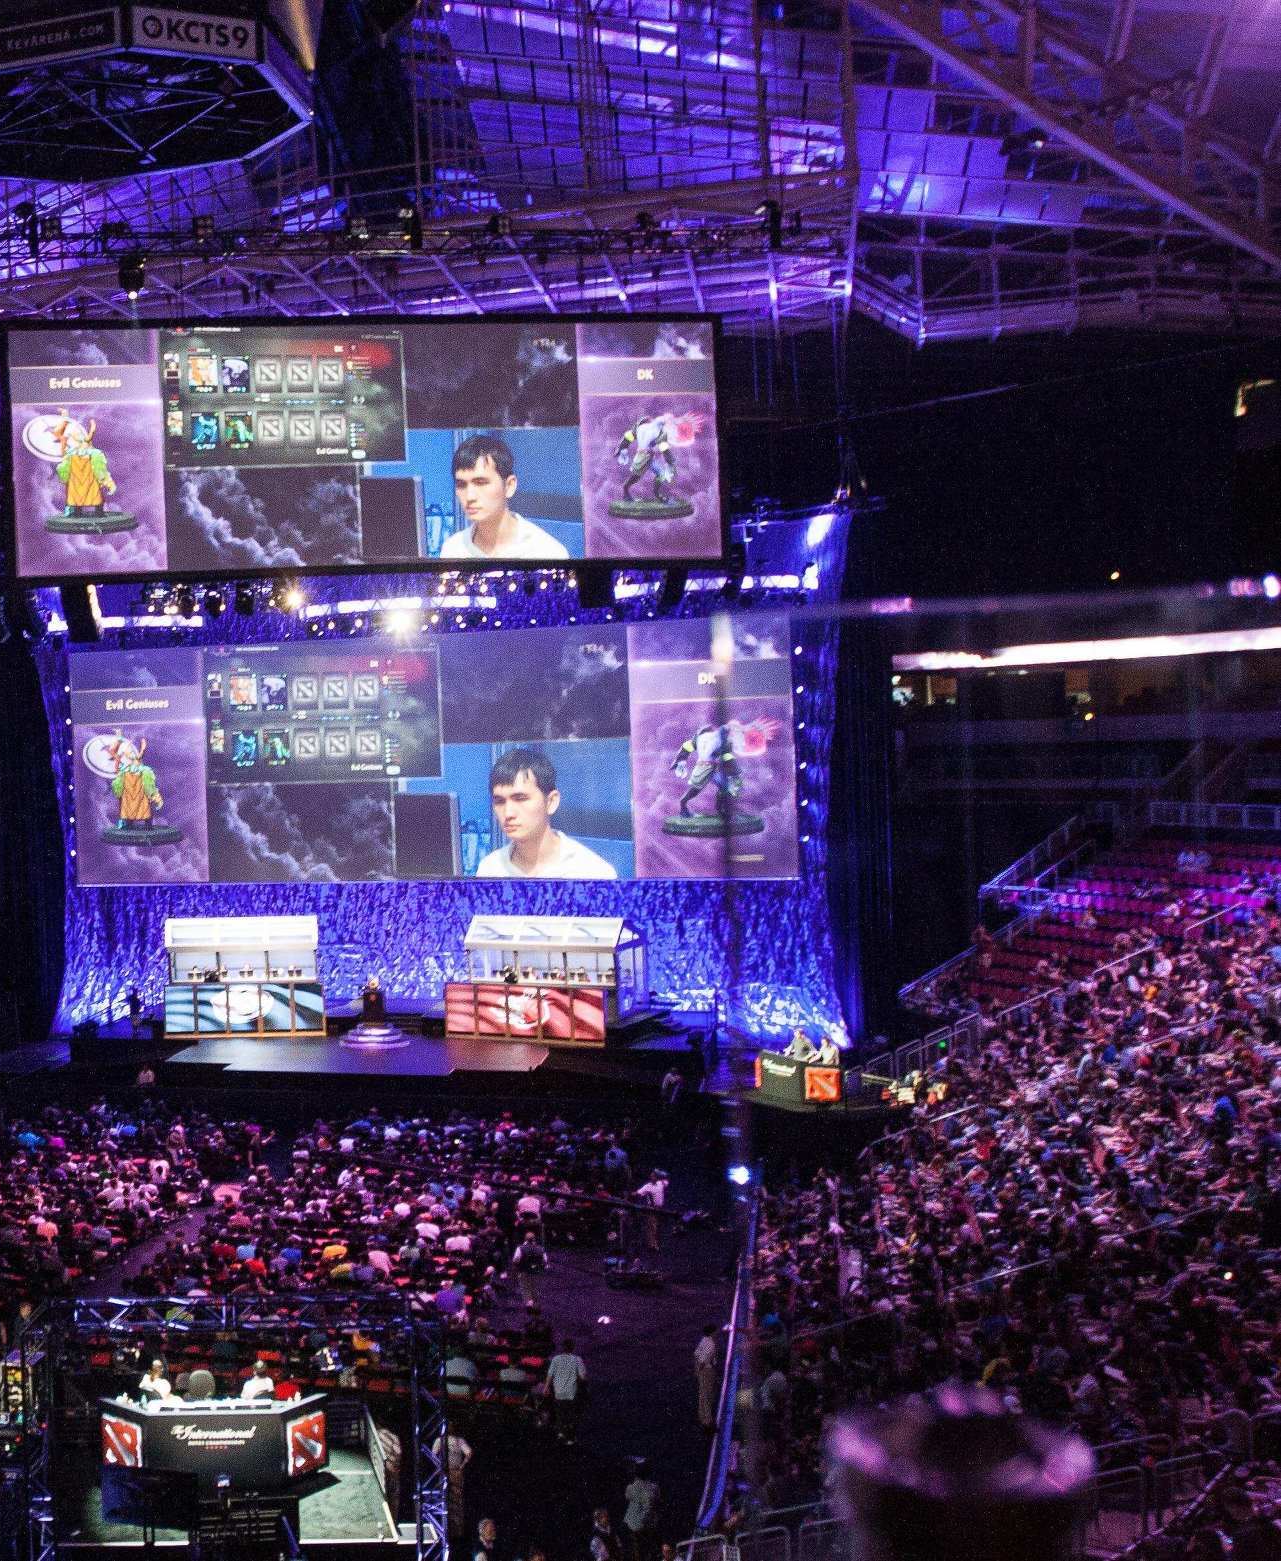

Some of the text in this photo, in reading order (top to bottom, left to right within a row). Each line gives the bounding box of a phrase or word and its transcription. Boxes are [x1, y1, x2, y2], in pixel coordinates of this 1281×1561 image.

[636, 368, 654, 381] DK
[48, 377, 70, 390] Evil
[105, 699, 124, 711] Evil
